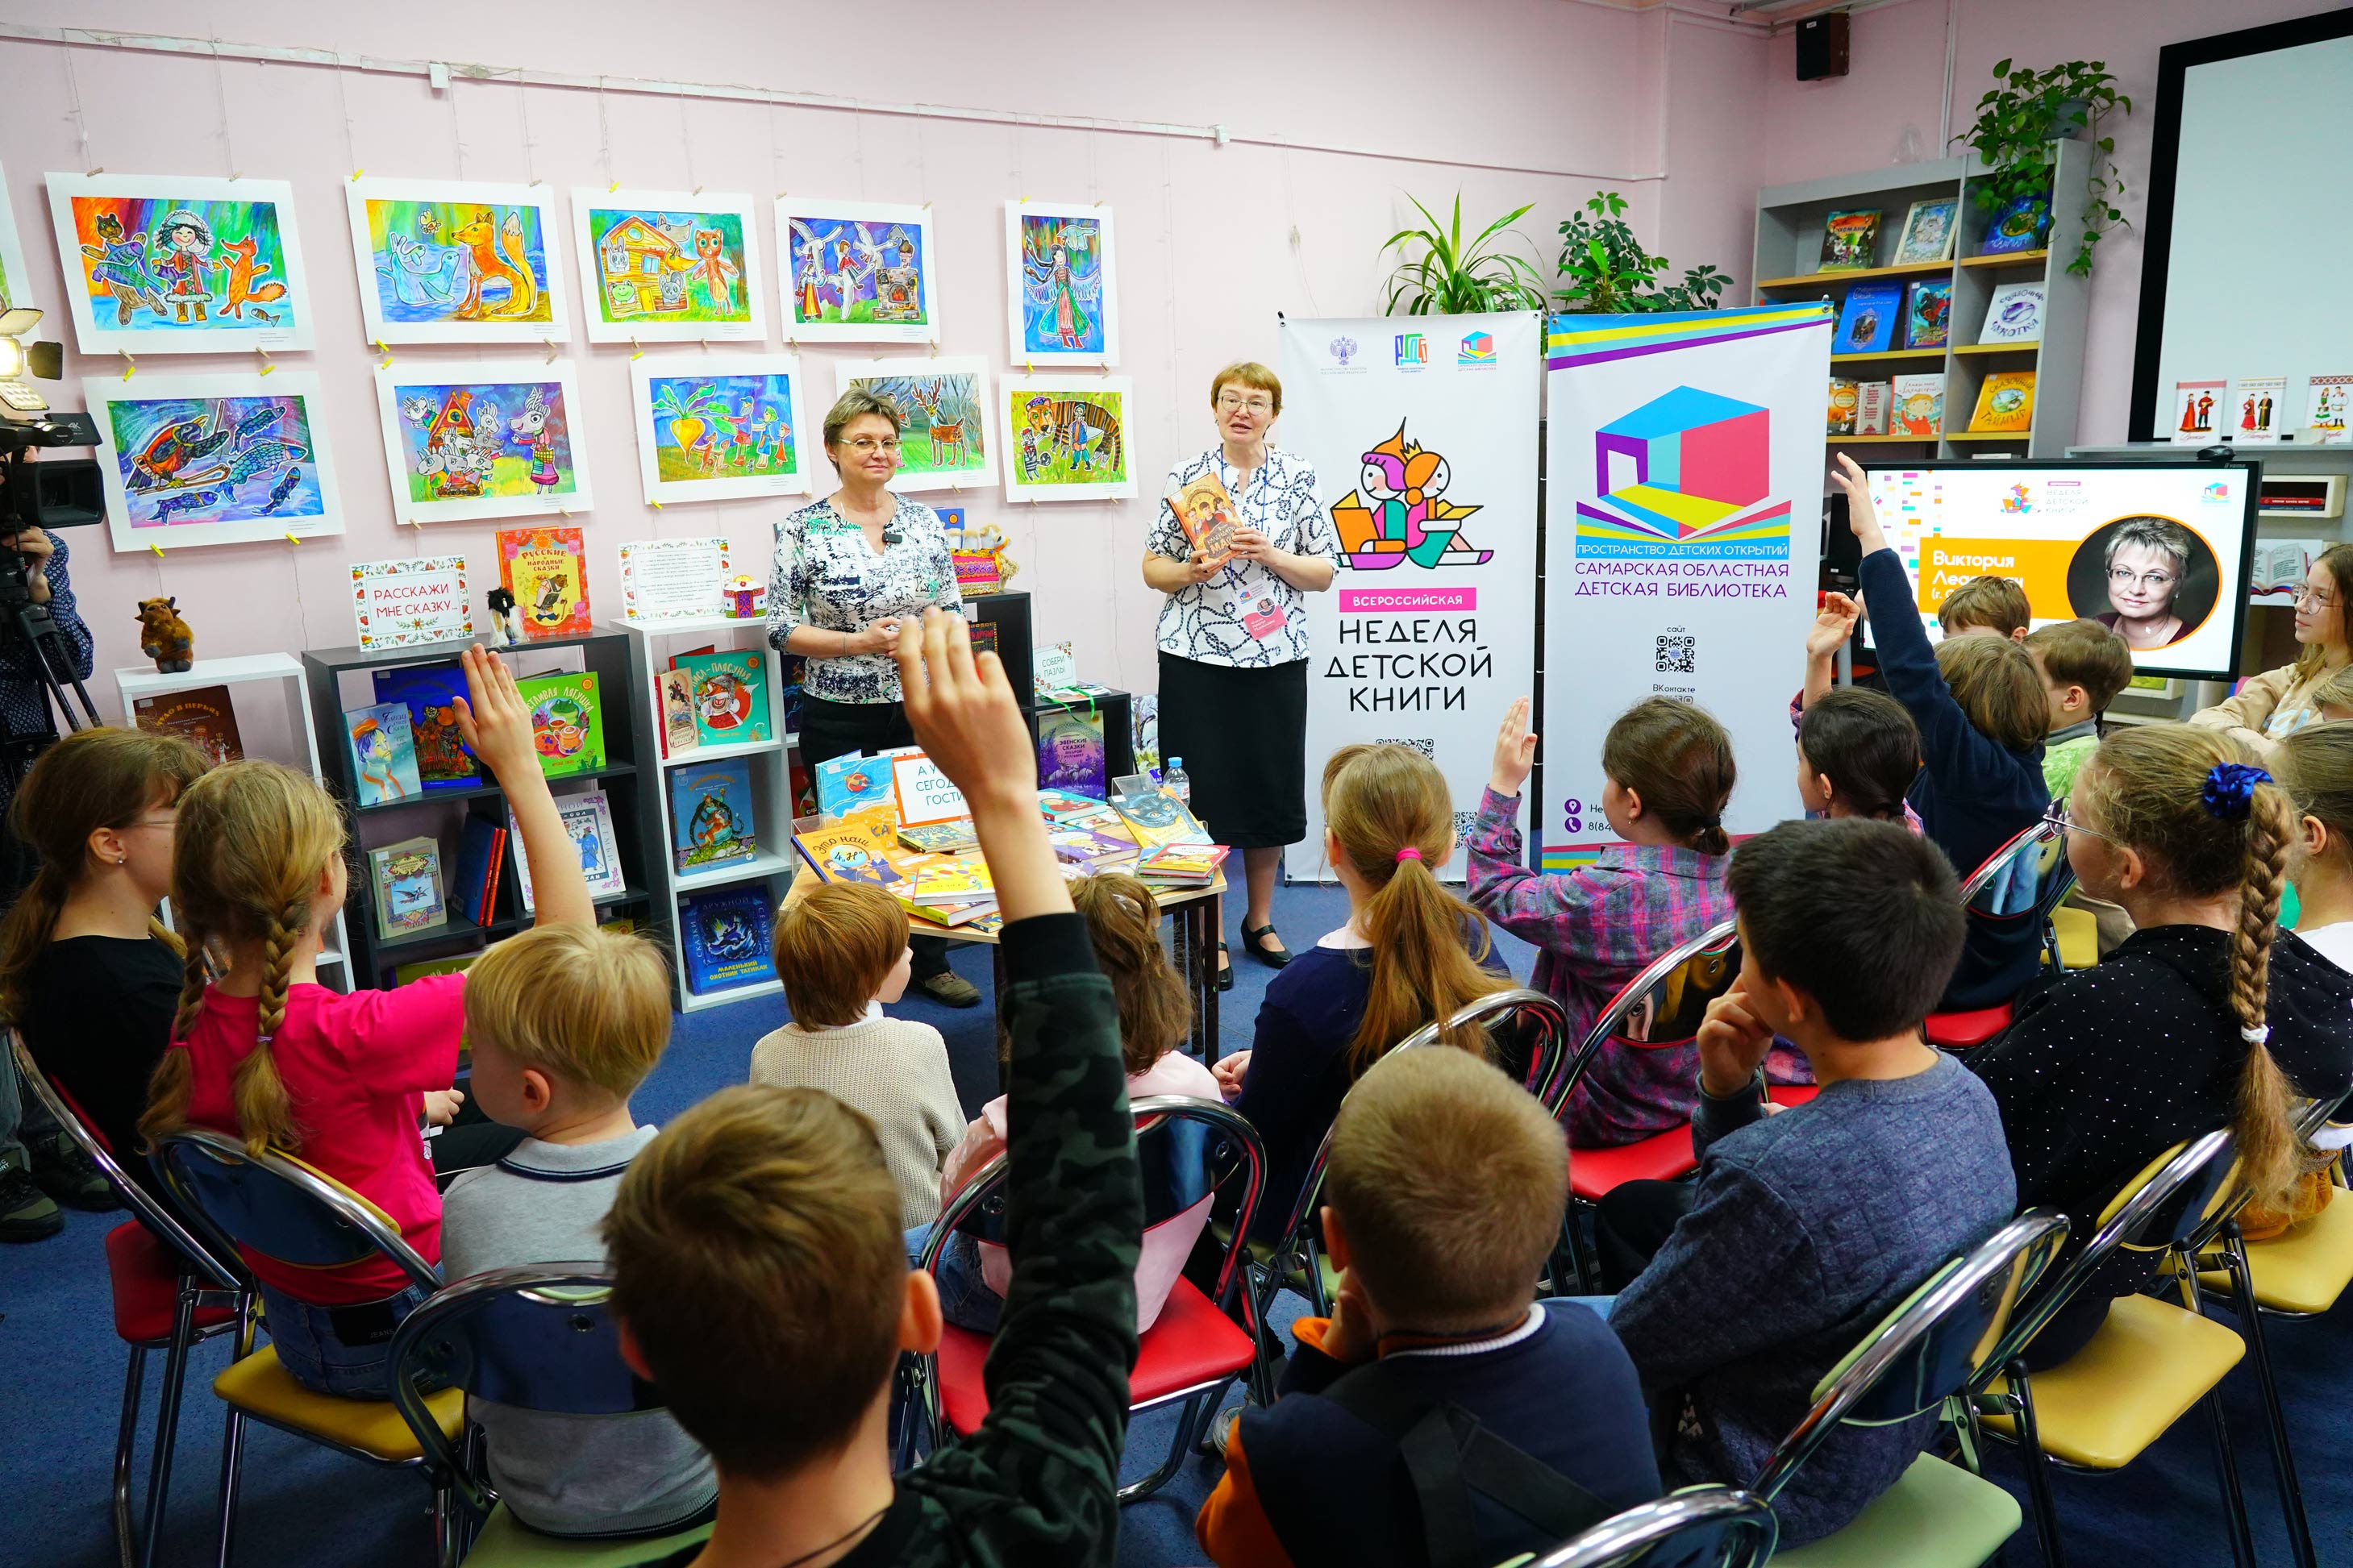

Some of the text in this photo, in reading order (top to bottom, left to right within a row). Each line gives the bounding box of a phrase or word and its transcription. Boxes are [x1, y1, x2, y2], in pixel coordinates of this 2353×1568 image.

[68, 422, 81, 430] 4K
[521, 548, 567, 560] РУССКИЕ
[1576, 543, 1789, 556] ПРОСТРАНСТВО ДЕТСКИХ ОТКРЫТИЙ
[527, 559, 564, 567] НАРОДНЫЕ
[1932, 549, 2015, 572] Виктория
[1575, 563, 1789, 577] САМАРСКАЯ ОБЛАСТНАЯ
[373, 584, 450, 601] РАССКАЖИ
[1575, 581, 1787, 598] ДЕТСКАЯ БИБЛИОТЕКА
[1352, 593, 1464, 607] ВСЕРОССИЙСКАЯ
[376, 605, 403, 618] МНЕ
[1339, 618, 1476, 644] НЕДЕЛЯ
[1666, 625, 1686, 633] сайт
[1041, 655, 1066, 668] СОБЕРИ
[1323, 646, 1492, 680] ДЕТСКОЙ
[1043, 666, 1066, 678] ПАЗЛЫ
[1652, 684, 1696, 693] ВКонтакте
[1350, 685, 1465, 712] КНИГИ
[918, 766, 928, 776] А
[916, 778, 956, 792] СЕГОД
[1588, 821, 1612, 832] 8(84
[813, 836, 870, 855] Это наш
[689, 921, 703, 958] СКАЗКИ
[718, 960, 758, 972] МАЛЕНЬКИЙ
[709, 971, 739, 980] ОХОТНИК
